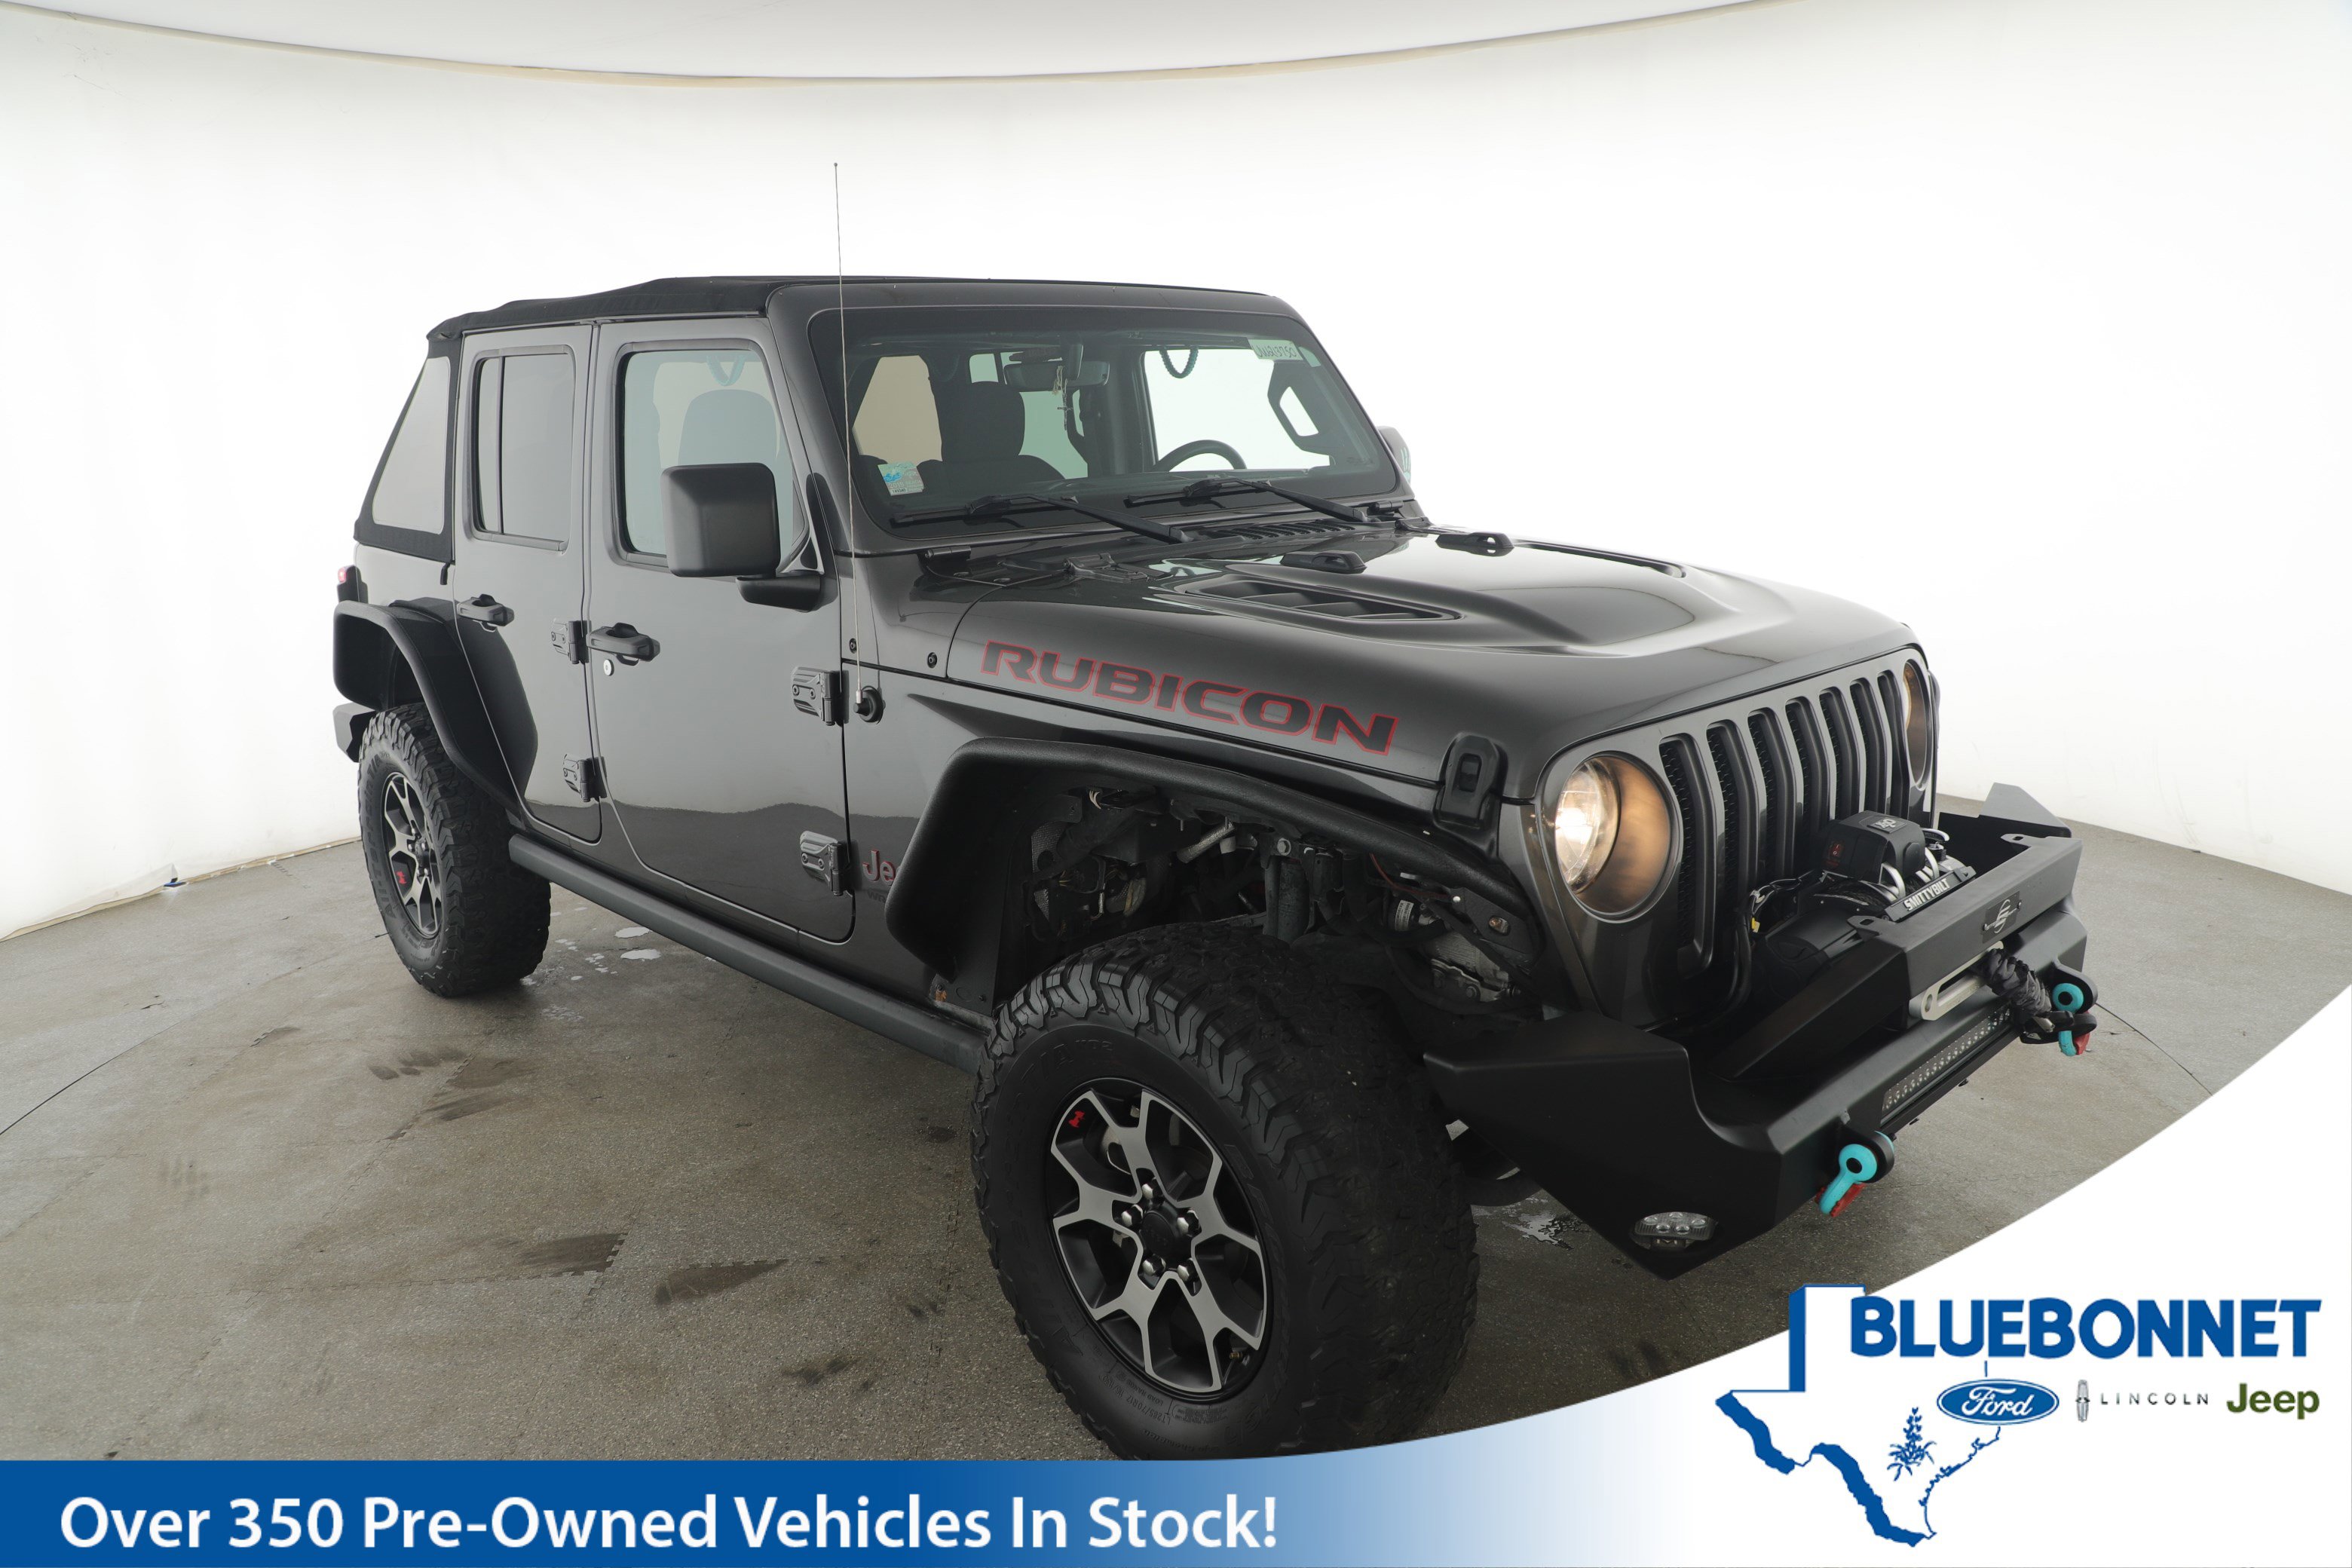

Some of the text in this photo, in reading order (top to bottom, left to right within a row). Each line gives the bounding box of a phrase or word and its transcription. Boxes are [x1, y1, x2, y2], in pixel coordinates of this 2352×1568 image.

[981, 639, 1400, 756] RUBICON
[862, 849, 896, 886] Je
[1903, 877, 1950, 911] SMITTYBILT
